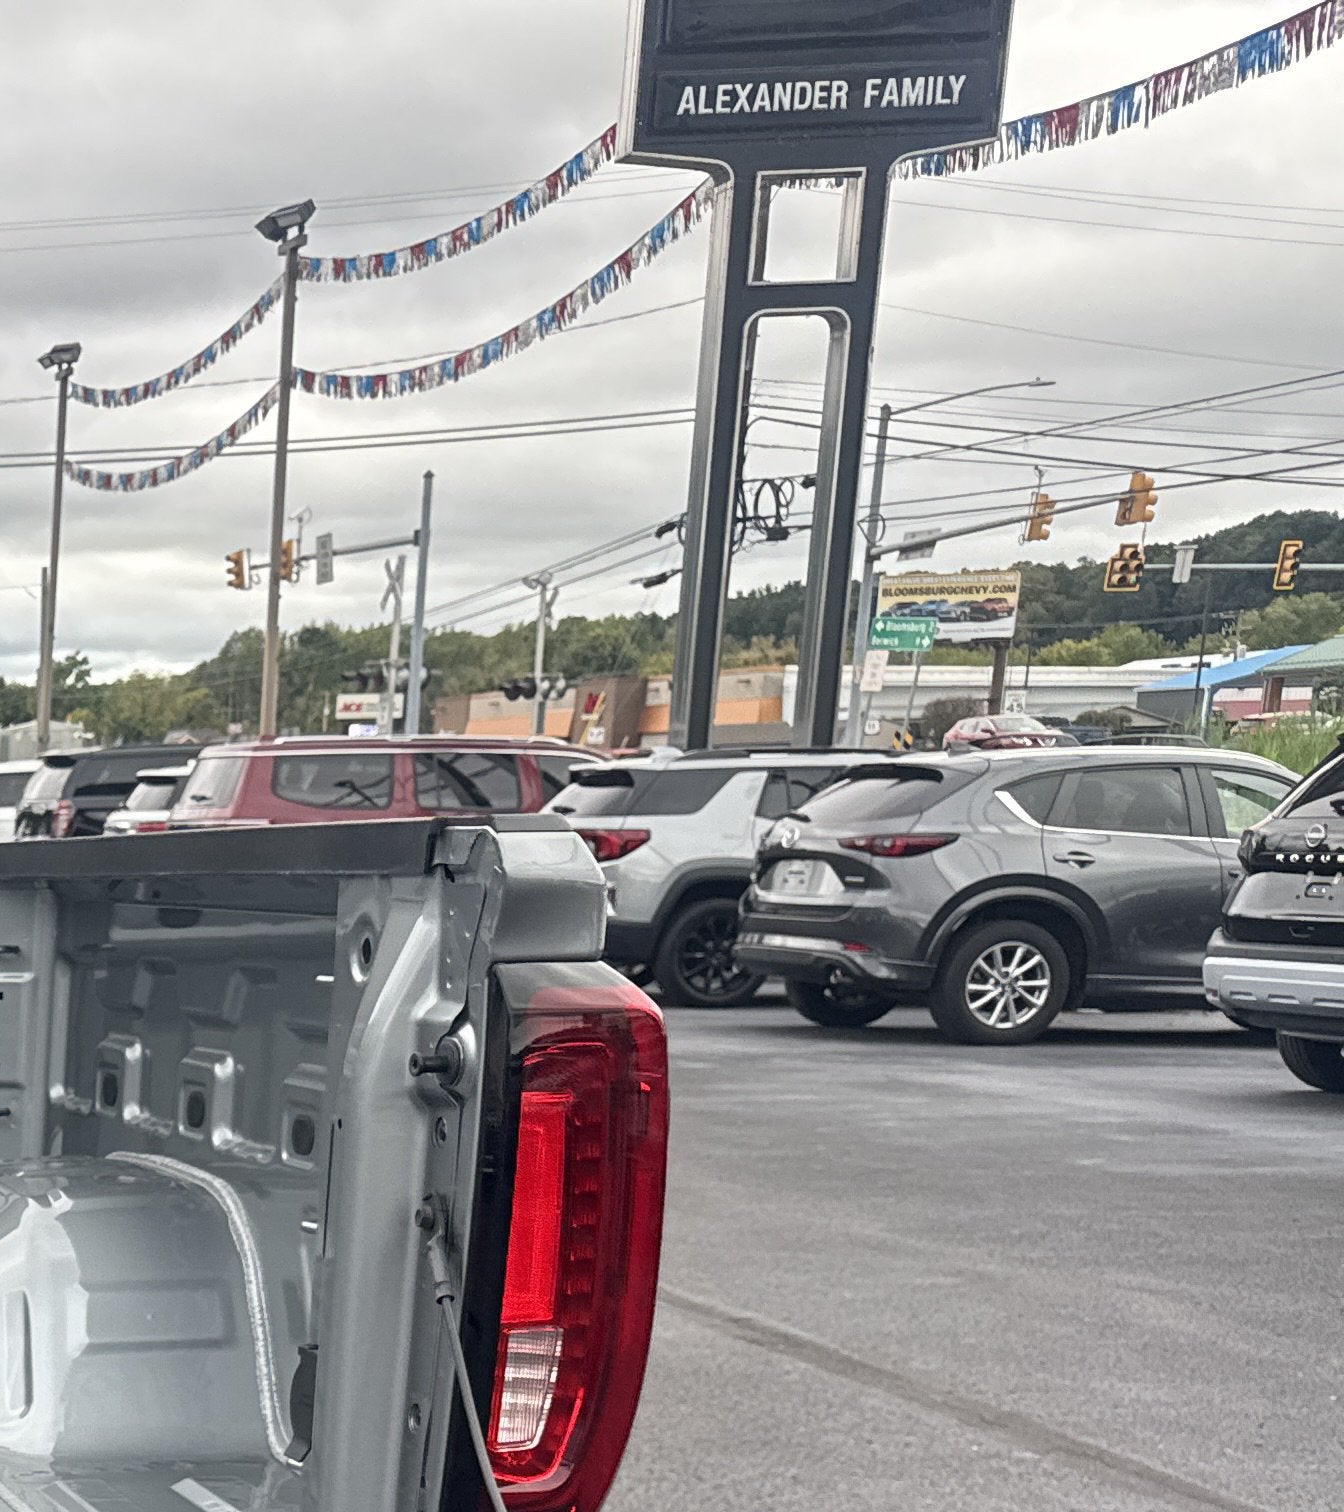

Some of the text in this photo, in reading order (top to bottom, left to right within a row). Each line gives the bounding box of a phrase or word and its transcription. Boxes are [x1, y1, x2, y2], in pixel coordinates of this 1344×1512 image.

[676, 75, 967, 115] ALEXANDER FAMILY
[882, 585, 1017, 597] BLOOMSBURGCHEVY.COM
